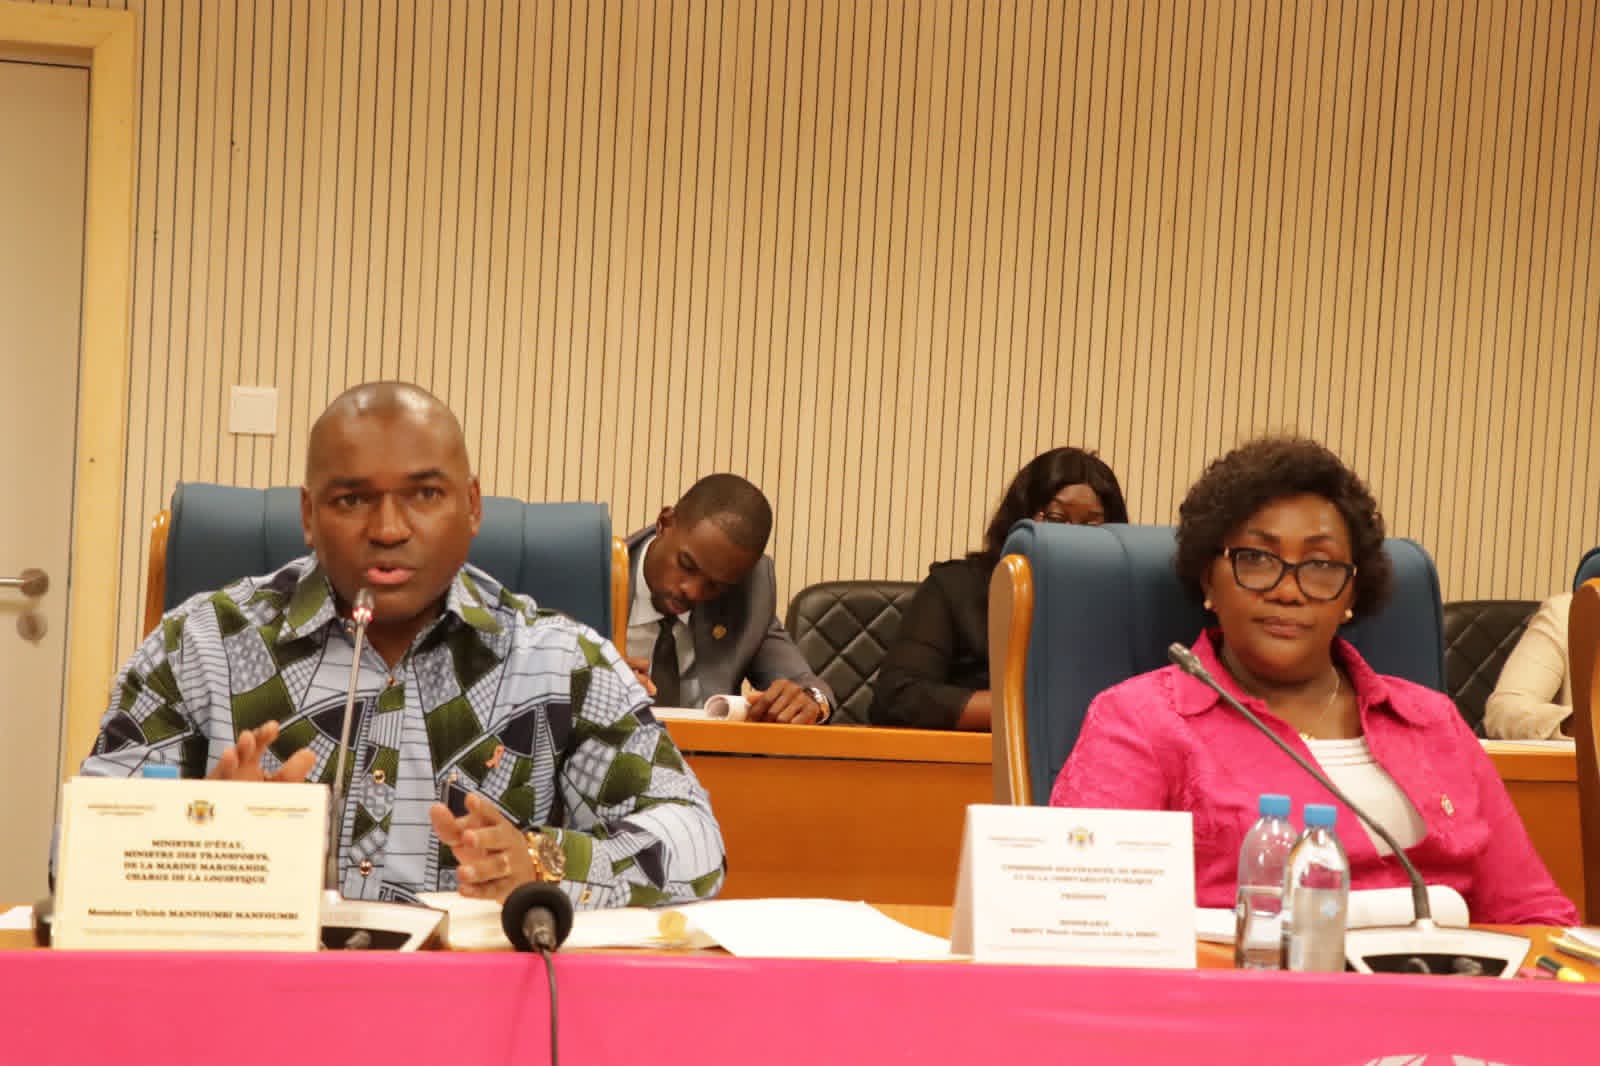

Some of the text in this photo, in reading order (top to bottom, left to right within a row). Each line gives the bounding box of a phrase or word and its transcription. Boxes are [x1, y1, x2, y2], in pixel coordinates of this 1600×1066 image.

[152, 839, 201, 848] MINISTRE
[123, 850, 173, 859] MINISTRE
[176, 851, 197, 859] DES
[123, 862, 137, 870] DE
[140, 862, 153, 870] LA
[156, 862, 197, 871] MARINE
[188, 874, 201, 882] LA
[204, 875, 265, 884] LOGISTIQUE
